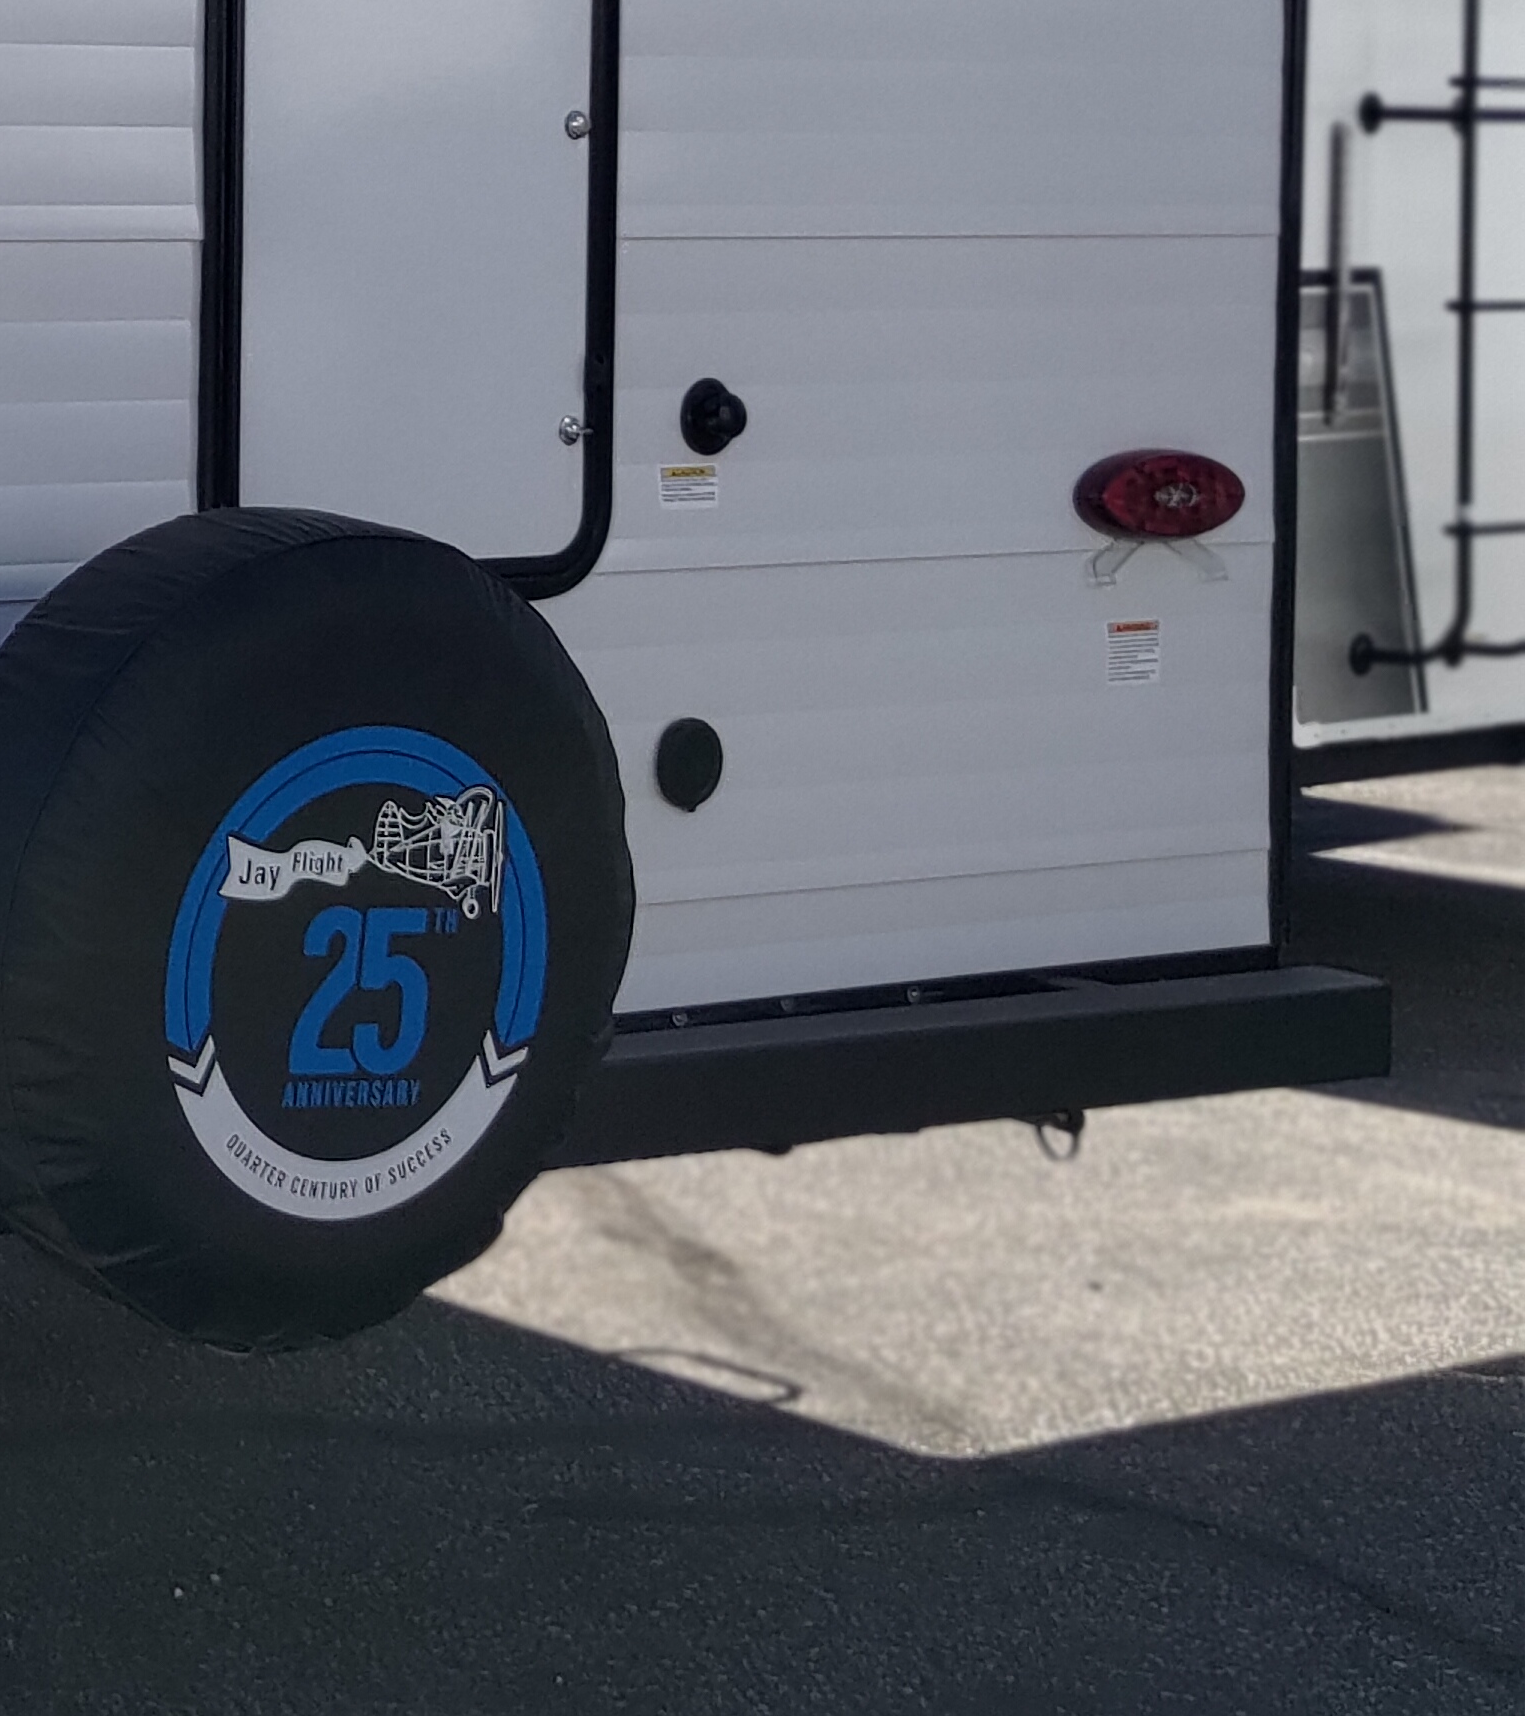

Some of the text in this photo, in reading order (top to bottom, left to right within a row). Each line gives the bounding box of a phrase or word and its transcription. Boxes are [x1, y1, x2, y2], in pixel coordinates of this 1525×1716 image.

[238, 851, 344, 891] Jay Flight
[281, 1079, 422, 1109] ANNIVERSARY
[225, 1127, 453, 1200] QUARTER CENTURY OF SUCCESS
